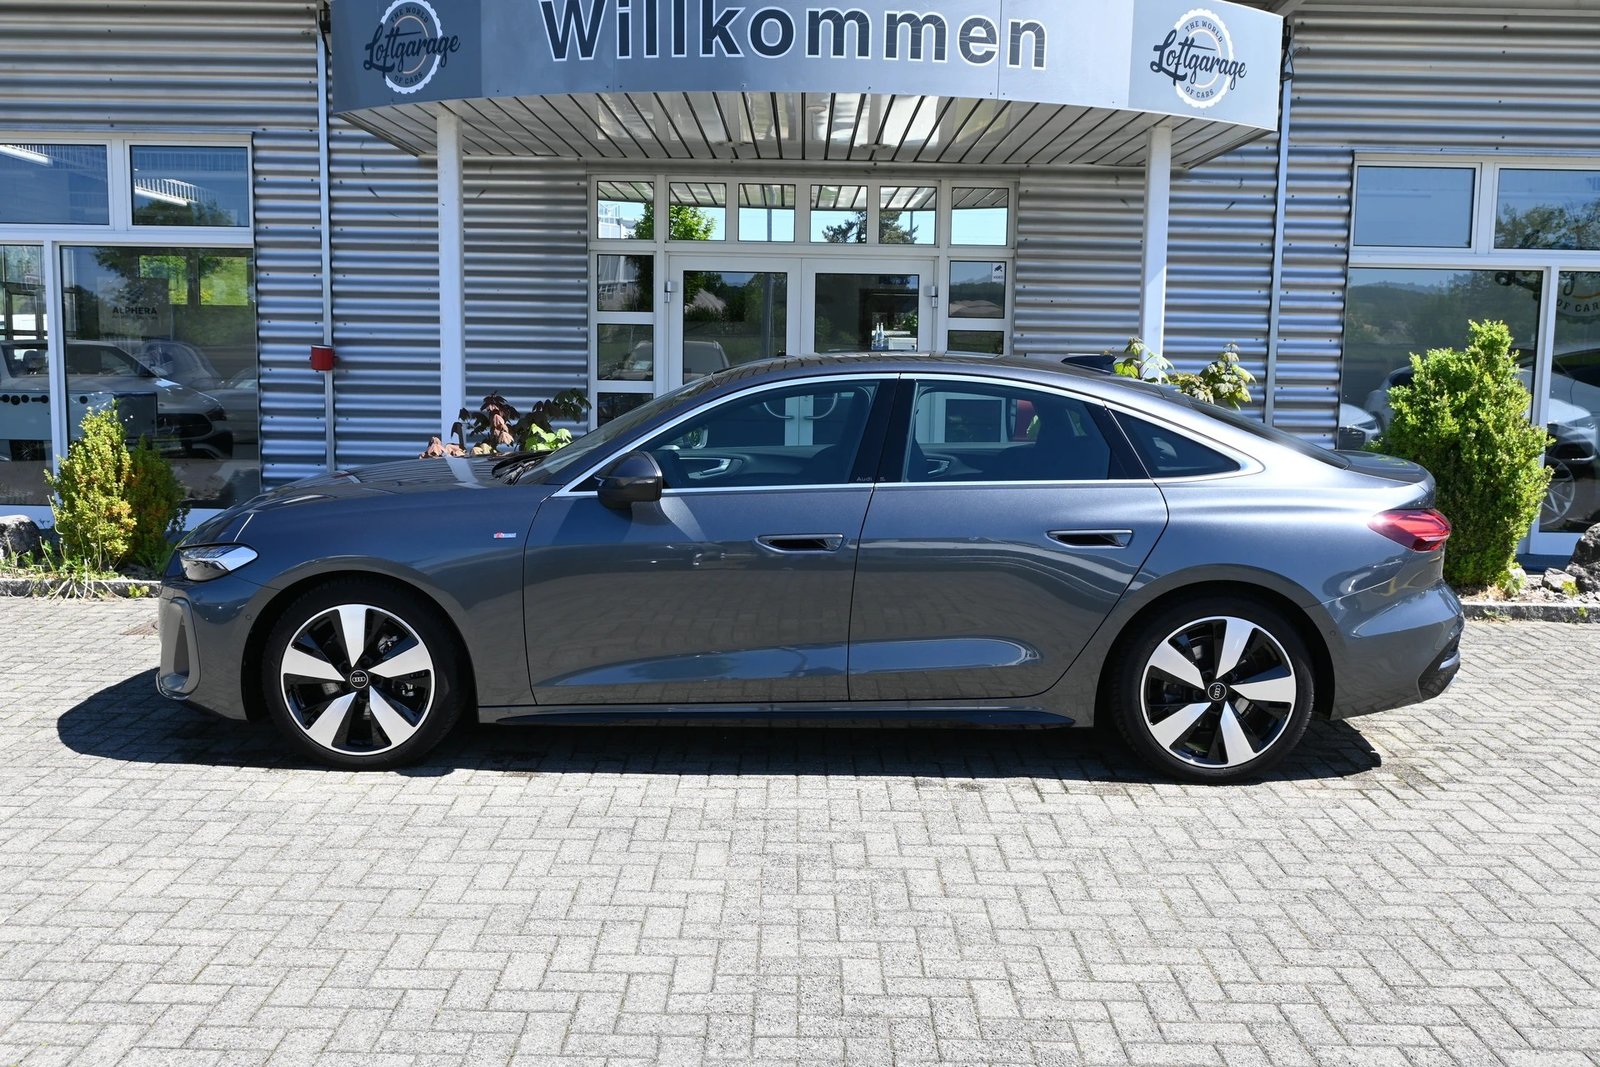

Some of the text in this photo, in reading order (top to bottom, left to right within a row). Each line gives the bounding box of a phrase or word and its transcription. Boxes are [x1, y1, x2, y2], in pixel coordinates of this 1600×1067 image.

[391, 7, 429, 23] THE WORLD
[538, 0, 1047, 70] Willkommen
[1185, 20, 1223, 43] THE WORLD
[363, 22, 460, 79] Loftgarage
[1149, 29, 1247, 90] Loftgarage
[394, 72, 423, 85] OF CARS
[1185, 86, 1214, 98] OF CARS
[112, 306, 158, 315] ALPHERA
